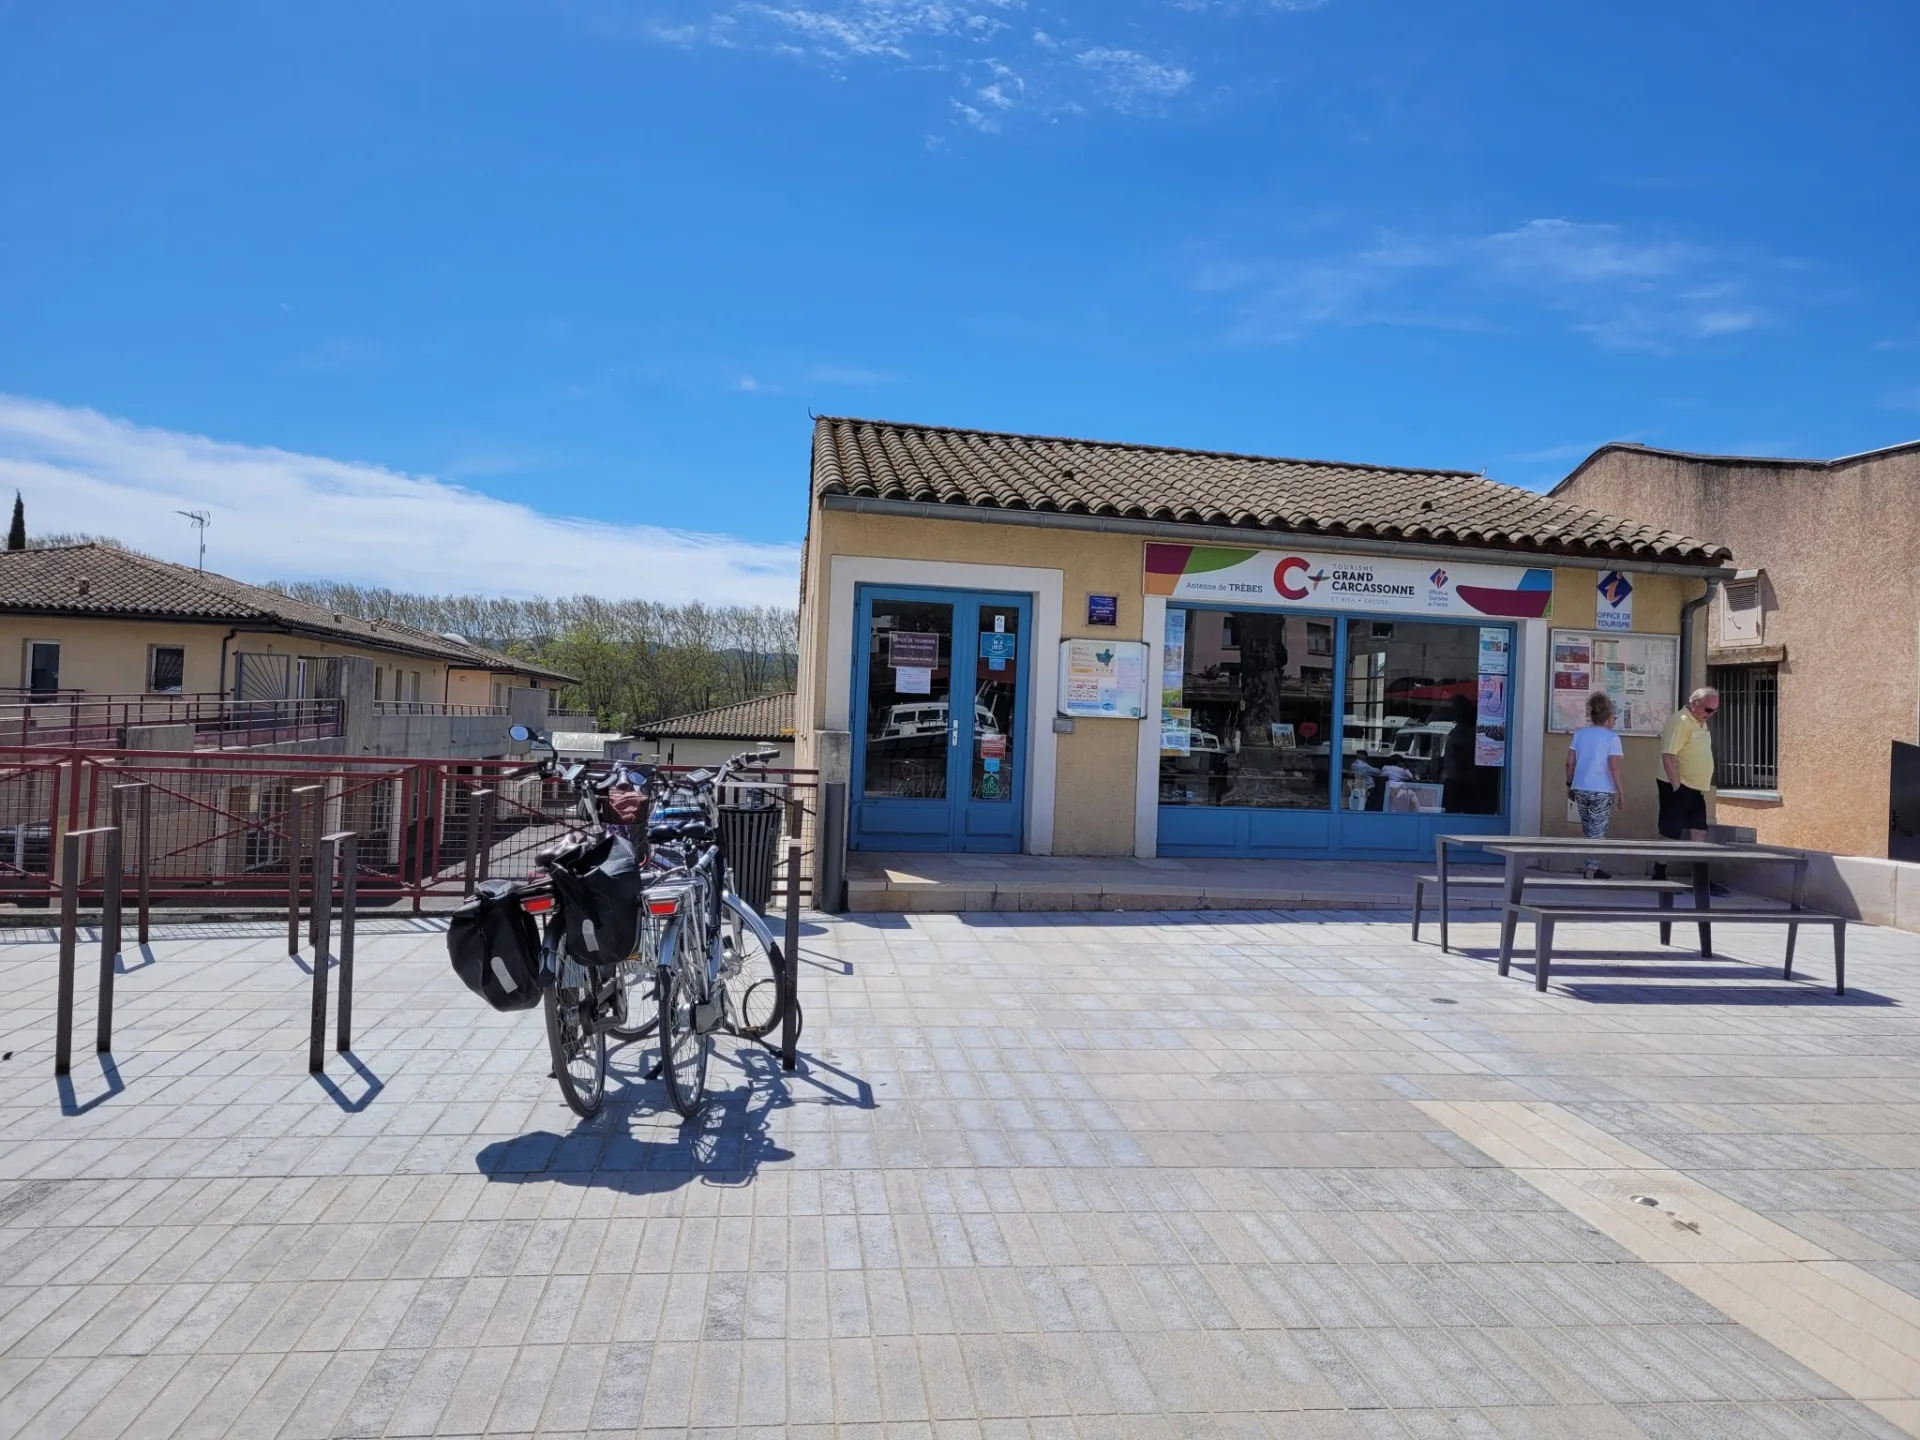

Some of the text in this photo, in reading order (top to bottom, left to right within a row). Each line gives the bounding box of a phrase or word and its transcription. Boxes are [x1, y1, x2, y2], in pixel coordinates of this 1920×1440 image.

[1333, 563, 1374, 572] TOURISME
[1332, 570, 1374, 582] GRAND
[1186, 581, 1263, 593] Antenne de TRÈBES
[1331, 581, 1415, 596] CARCASSONNE
[1597, 611, 1631, 620] OFFICE DE
[1597, 619, 1631, 628] TOURISME
